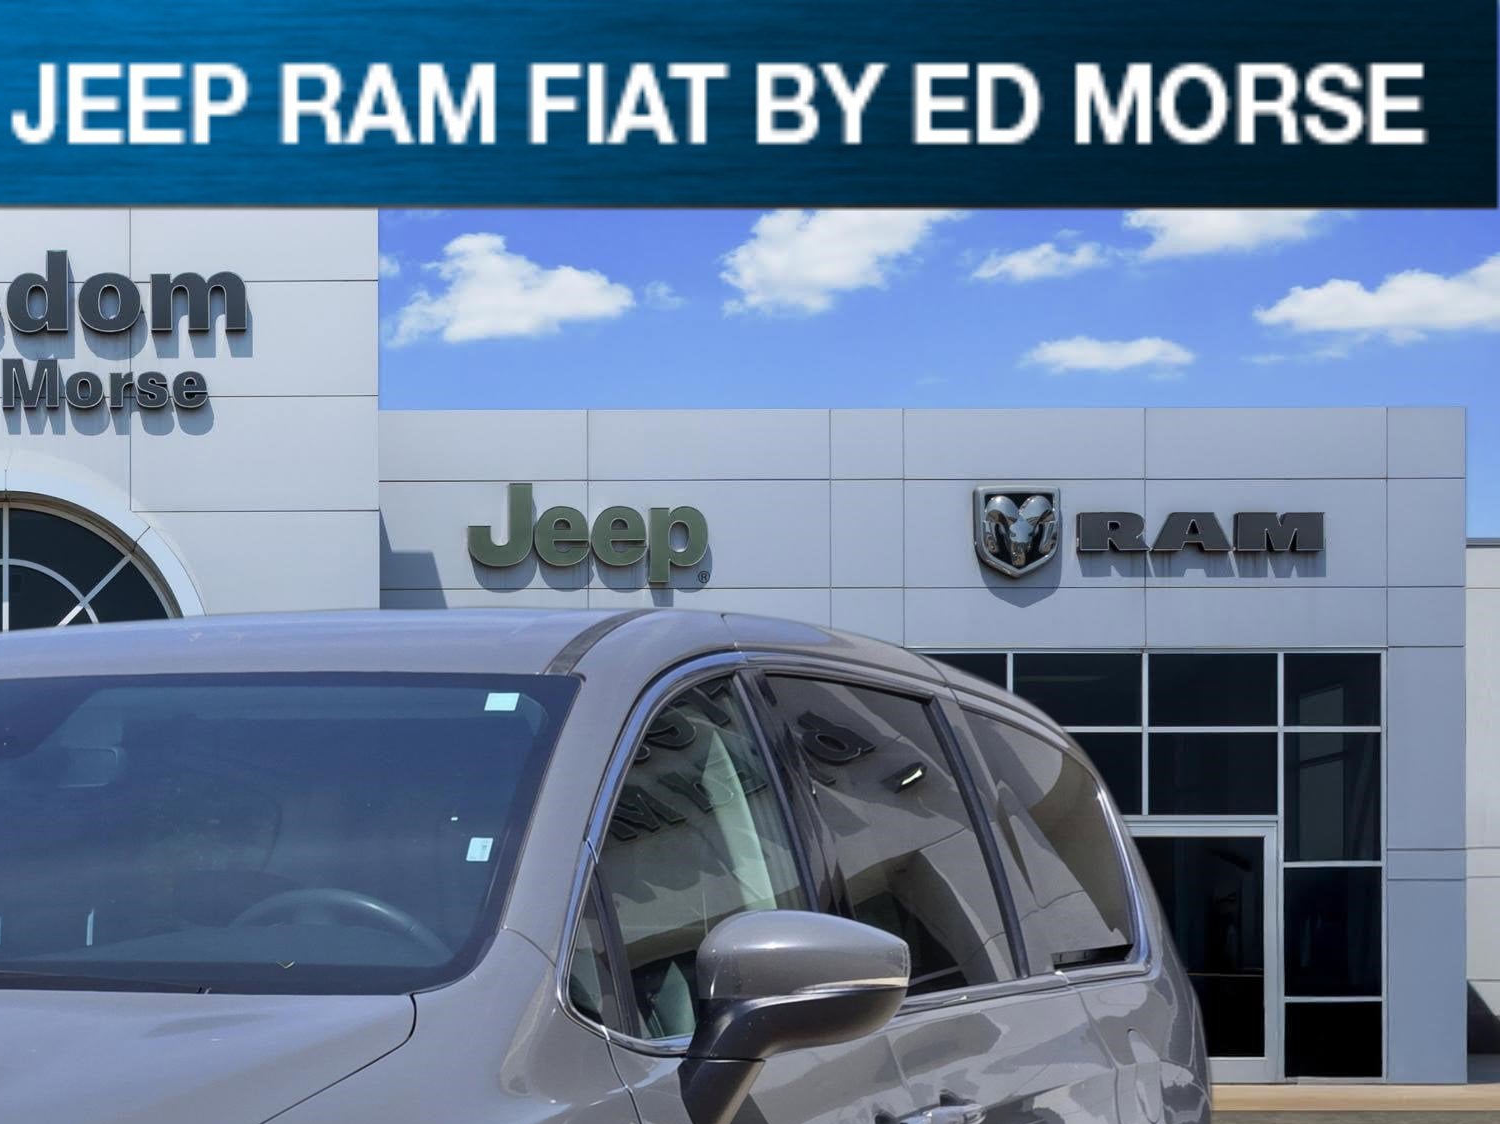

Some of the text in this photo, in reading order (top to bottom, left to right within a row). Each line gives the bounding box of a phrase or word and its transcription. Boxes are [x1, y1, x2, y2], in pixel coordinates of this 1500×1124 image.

[2, 359, 209, 409] Morse
[467, 483, 709, 584] Jeep
[1076, 511, 1325, 553] RAM
